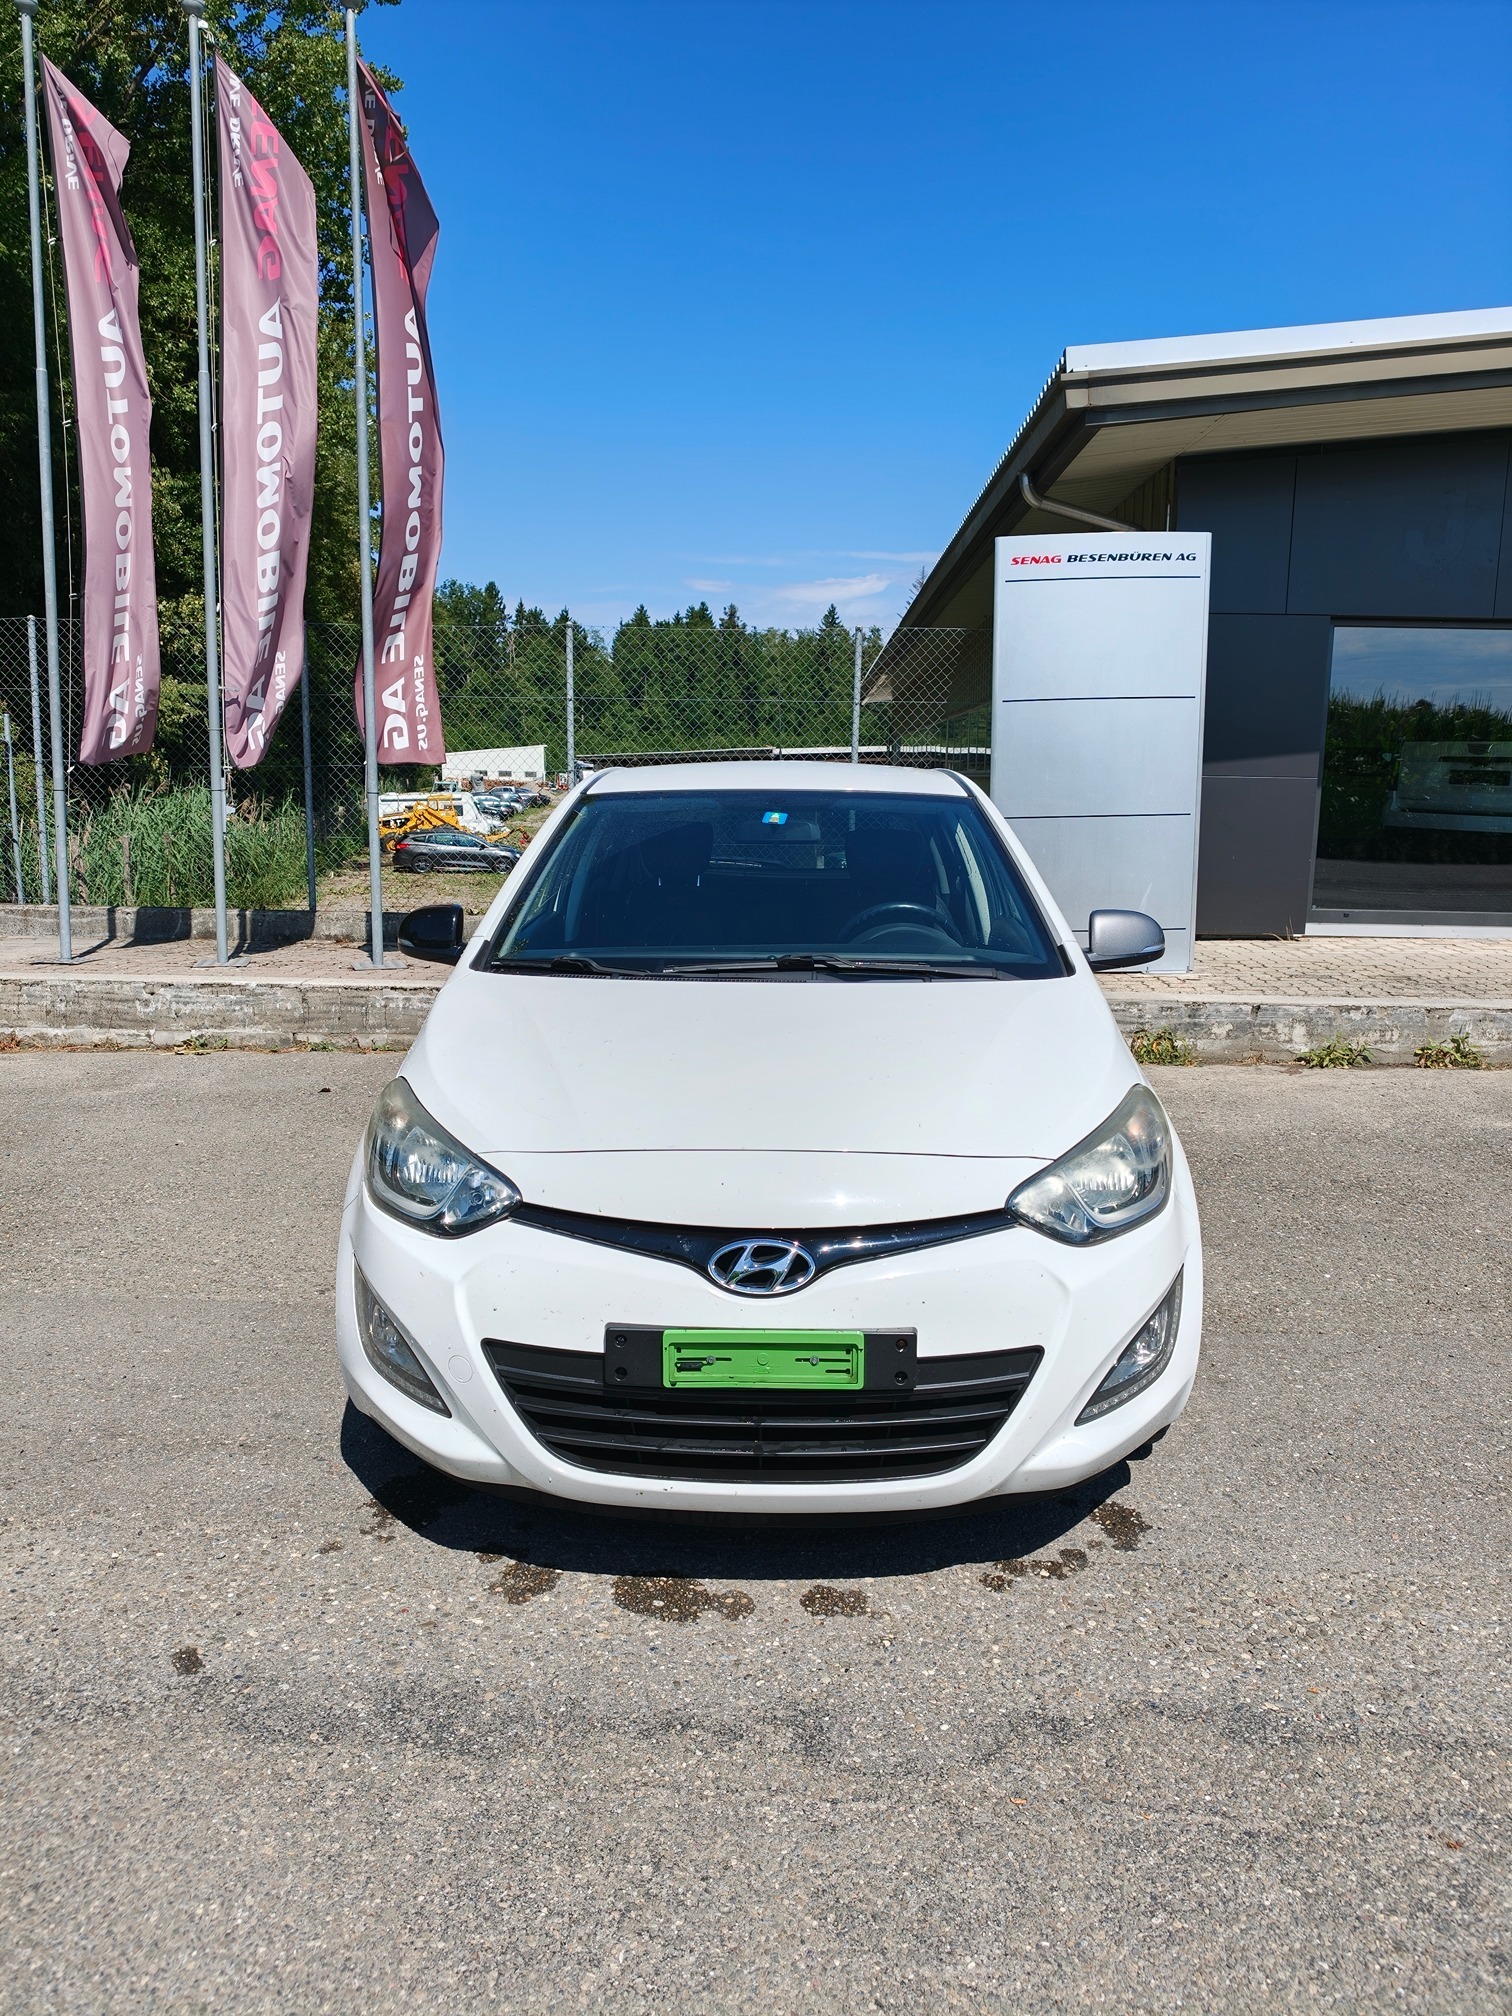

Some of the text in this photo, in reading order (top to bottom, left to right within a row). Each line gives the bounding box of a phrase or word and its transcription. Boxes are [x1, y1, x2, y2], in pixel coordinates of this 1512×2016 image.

[1010, 551, 1197, 566] SENAG BESENBÜREN AG
